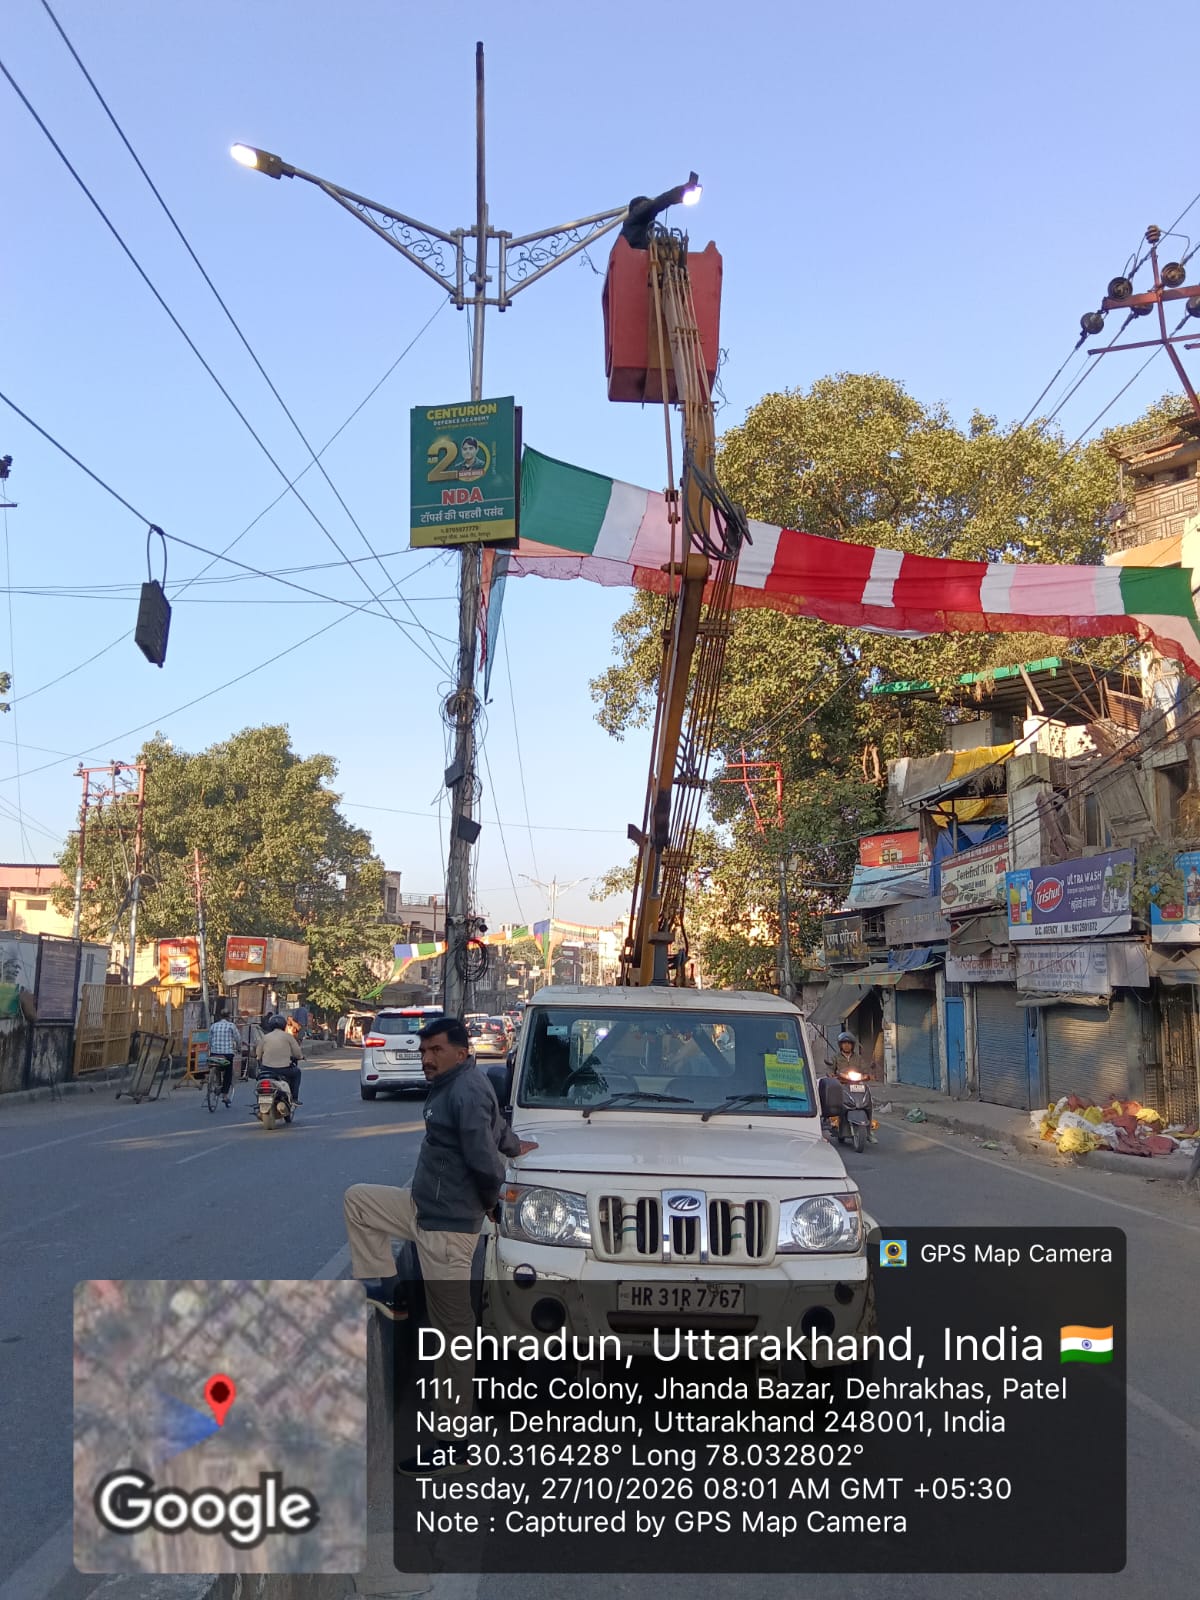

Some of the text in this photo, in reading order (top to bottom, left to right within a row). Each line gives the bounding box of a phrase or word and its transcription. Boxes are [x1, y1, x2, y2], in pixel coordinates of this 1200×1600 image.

[426, 403, 497, 420] CENTURION
[441, 486, 484, 505] NDA
[420, 506, 504, 523] टॉपर्स की पहली पसंद
[1066, 870, 1102, 886] ULTRA WASH
[1036, 885, 1061, 905] Trishul
[631, 1286, 653, 1306] HR
[658, 1287, 692, 1307] 31R
